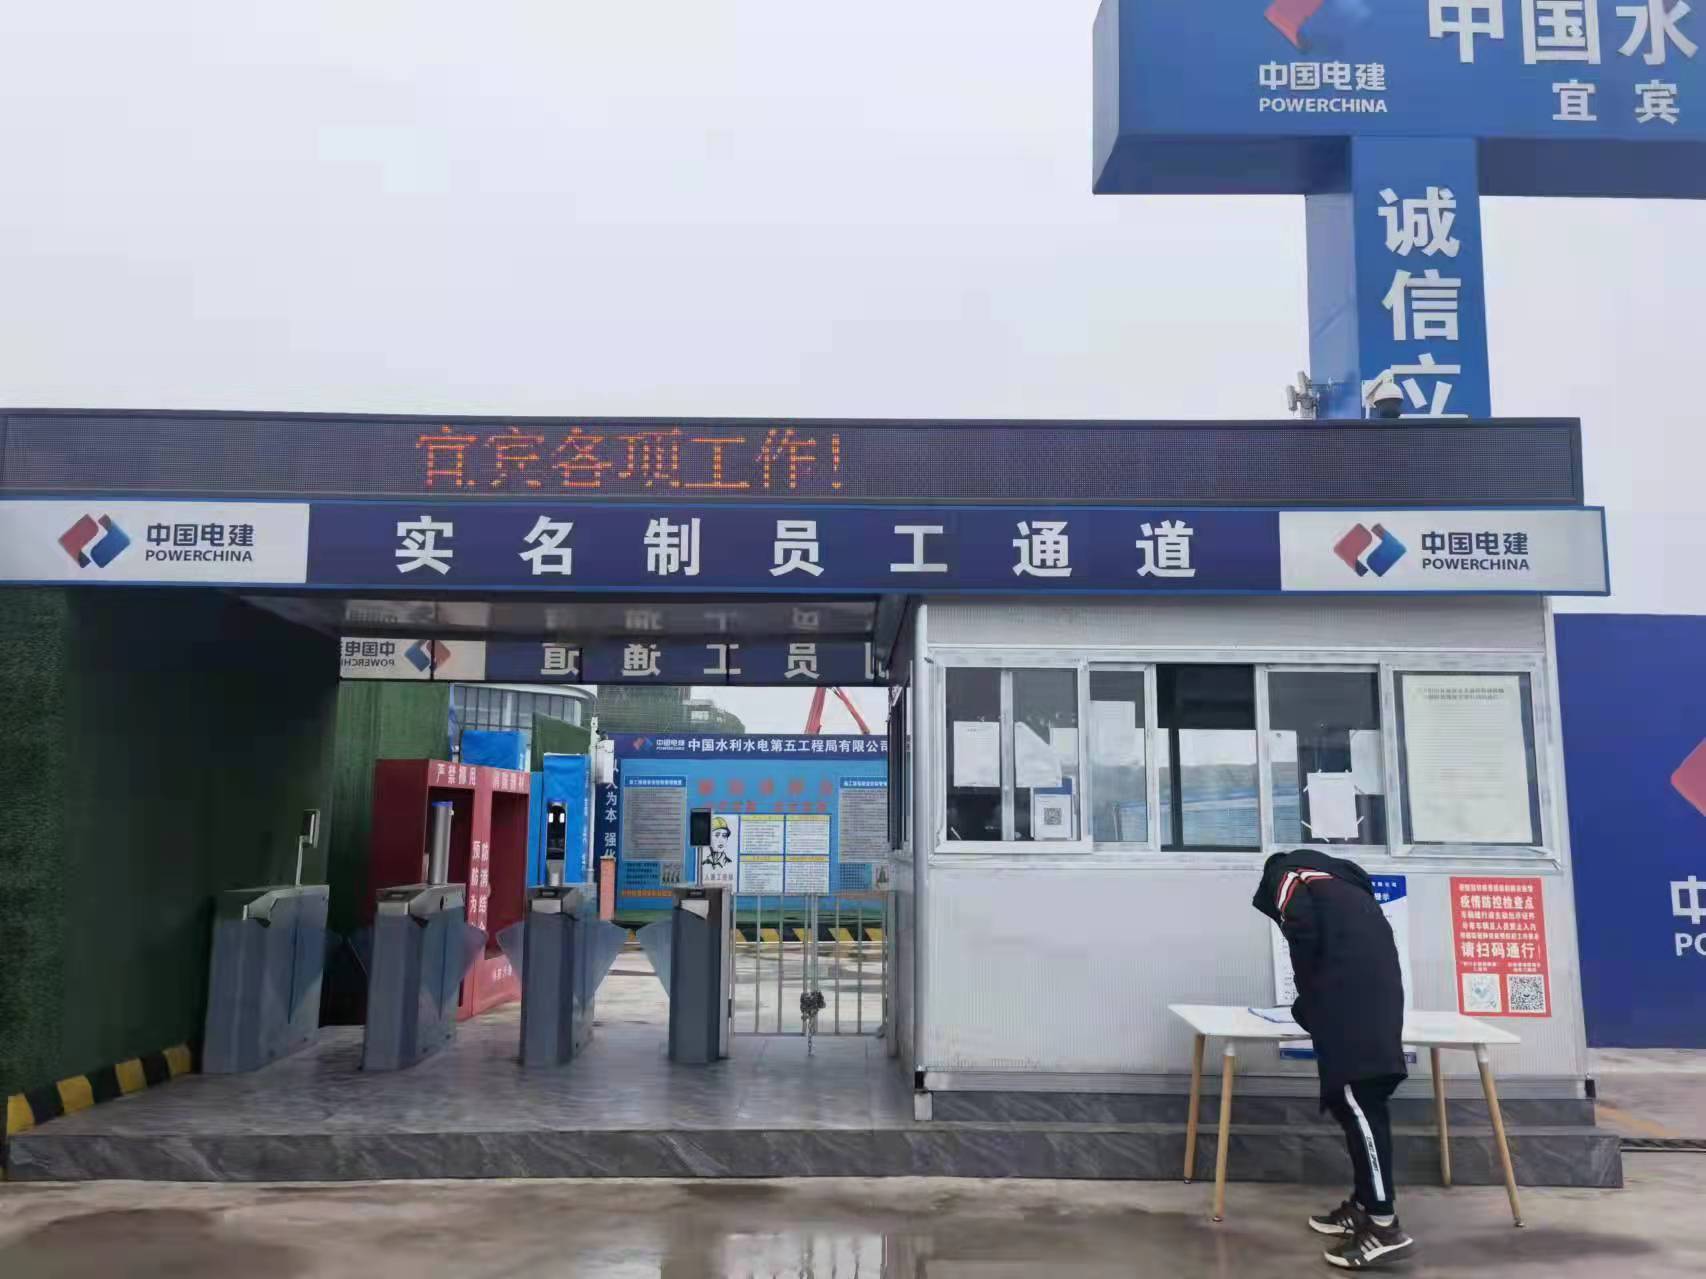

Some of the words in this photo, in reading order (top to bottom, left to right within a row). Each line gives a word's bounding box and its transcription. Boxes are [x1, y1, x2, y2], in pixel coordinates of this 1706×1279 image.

[1258, 61, 1388, 92] 中国电建
[1258, 98, 1388, 114] POWERCHINA
[1551, 79, 1681, 125] 宜宾
[146, 523, 255, 548] 中国电建
[395, 515, 1197, 578] 实名制员工通道
[1420, 530, 1530, 557] 中国电建
[145, 549, 254, 563] POWERCHINA
[1421, 557, 1531, 571] POWERCHINA
[688, 739, 888, 753] 中国水利水电第五工程局有限公司
[470, 841, 481, 928] 预防为
[1460, 894, 1535, 910] 疫情防控检查点
